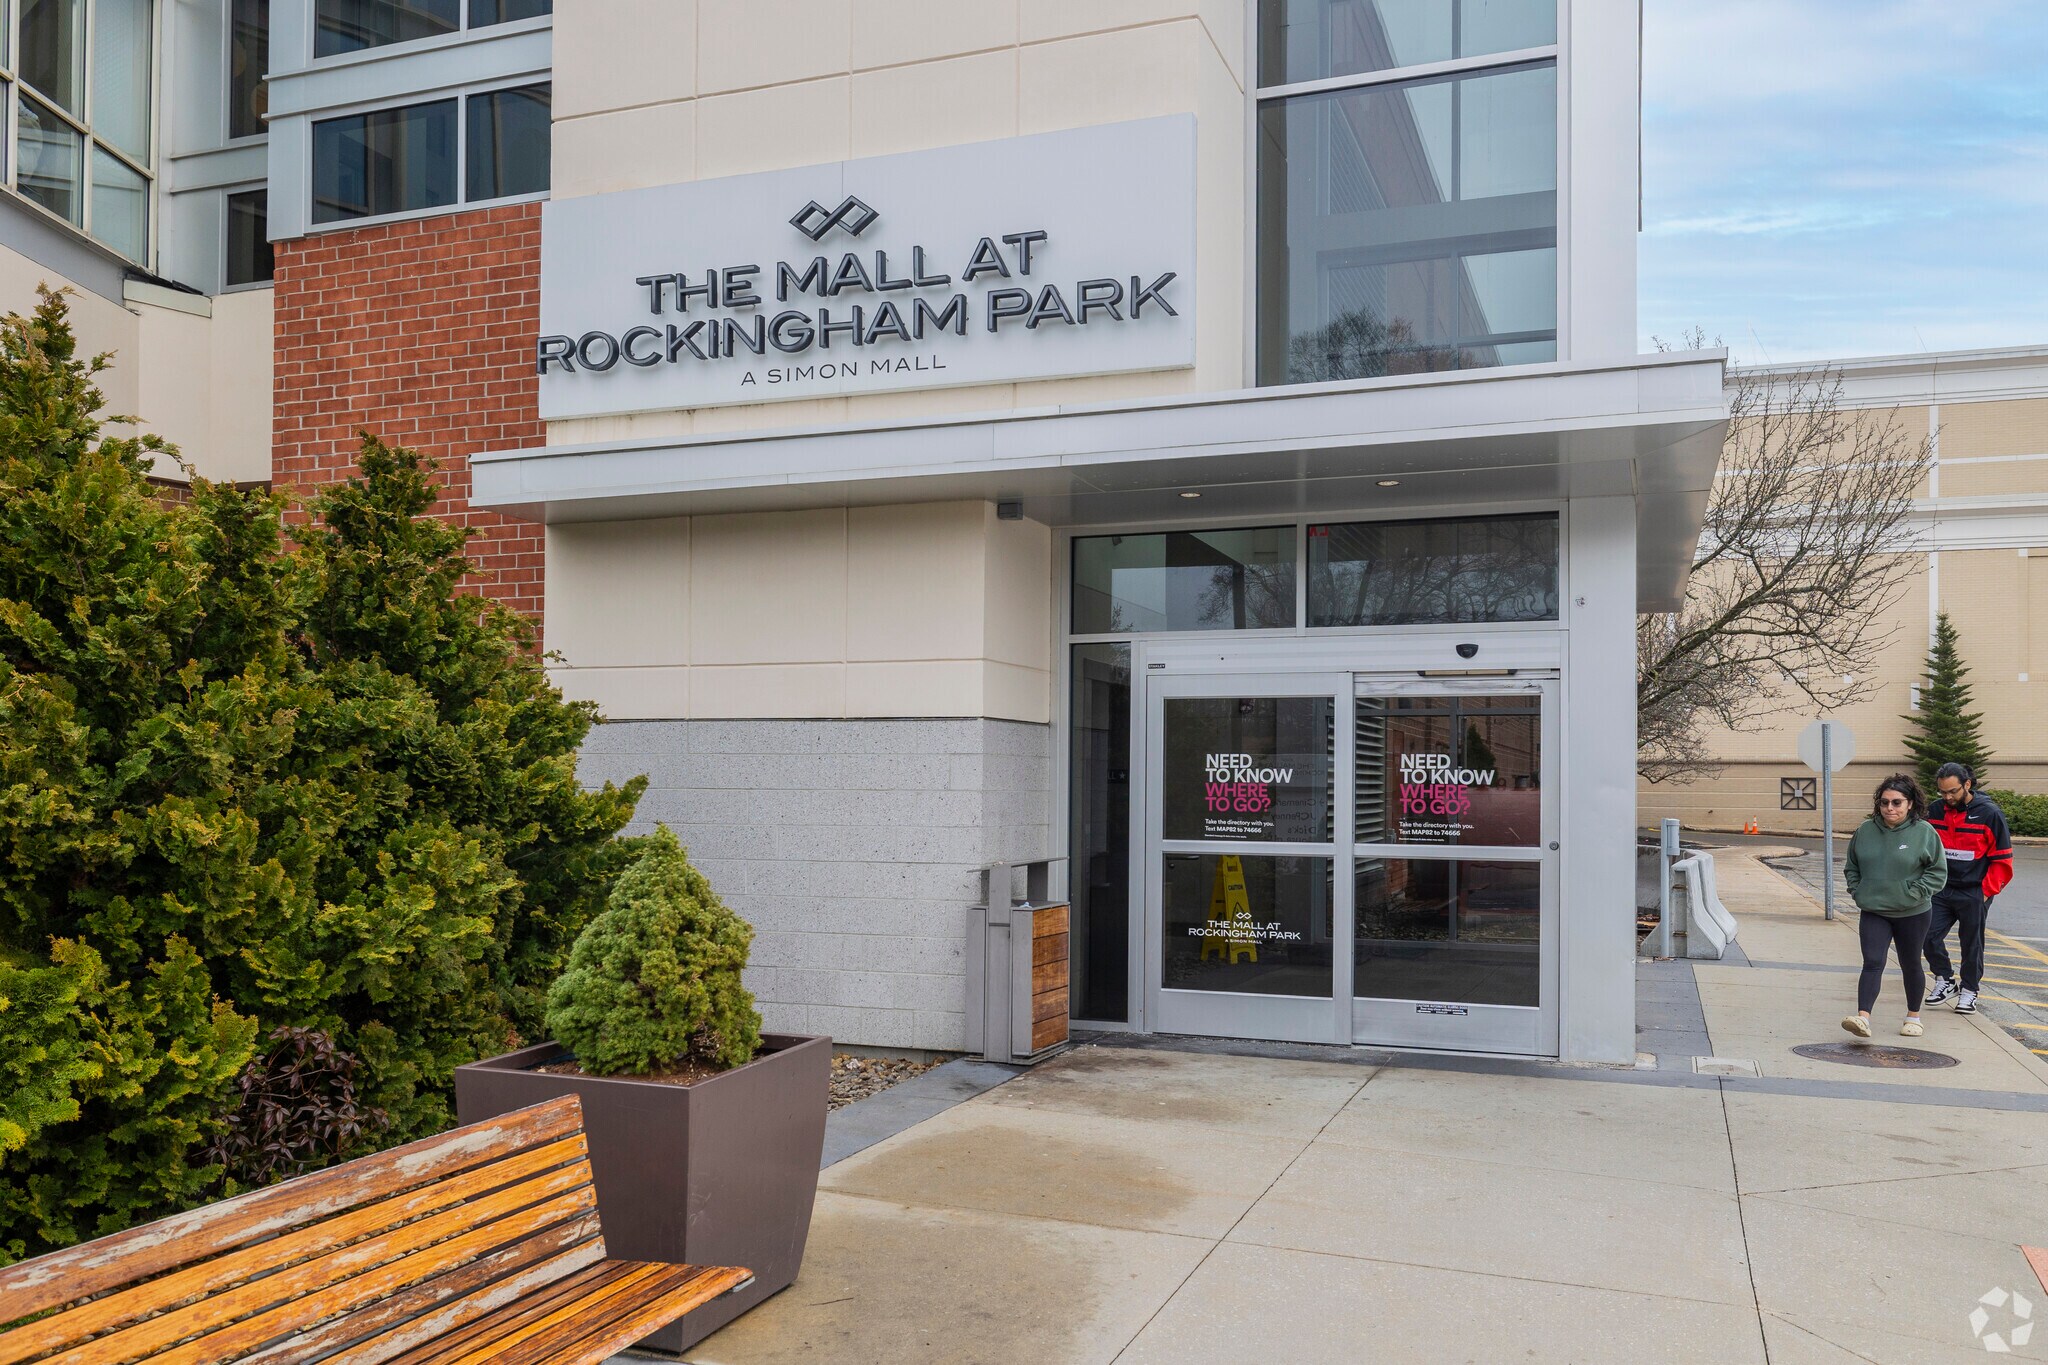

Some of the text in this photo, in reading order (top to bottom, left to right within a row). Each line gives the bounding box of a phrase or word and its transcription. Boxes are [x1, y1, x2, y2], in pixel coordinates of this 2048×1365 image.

[636, 230, 1048, 315] THE MALL AT
[537, 272, 1179, 375] ROCKINGHAM PARK
[741, 354, 946, 387] A SIMON MALL
[1206, 753, 1253, 769] NEED
[1400, 753, 1451, 769] NEED
[1205, 768, 1231, 783] TO
[1234, 768, 1293, 784] KNOW
[1400, 768, 1495, 785] TO KNOW
[1205, 782, 1268, 798] WHERE
[1400, 783, 1468, 800] WHERE
[1205, 797, 1271, 813] TO GO?
[1400, 798, 1471, 816] TO GO?
[1227, 819, 1250, 827] directory
[1207, 920, 1281, 931] THE MALL AT
[1188, 928, 1301, 940] ROCKINGHAM PARK
